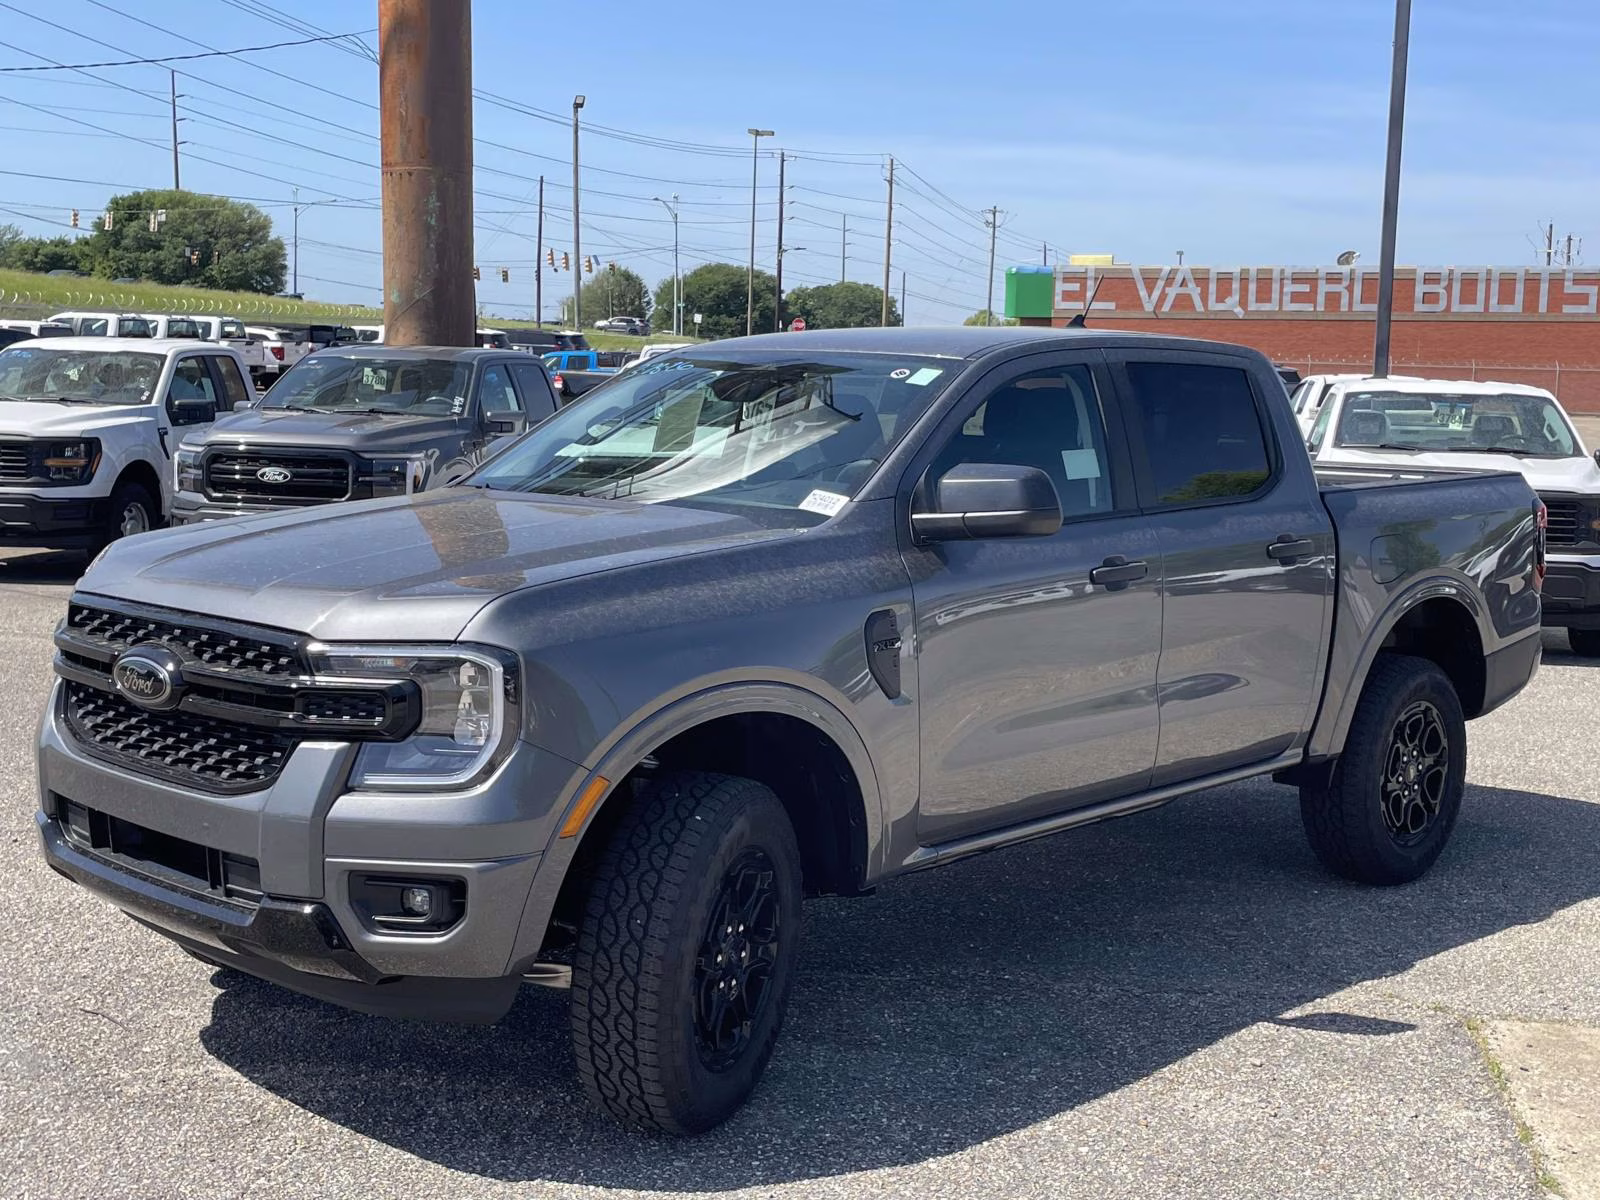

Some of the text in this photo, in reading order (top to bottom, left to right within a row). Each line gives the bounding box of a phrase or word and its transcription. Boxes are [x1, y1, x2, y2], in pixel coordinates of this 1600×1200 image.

[1054, 265, 1116, 310] EL
[1414, 265, 1599, 313] BOOTS
[124, 666, 154, 694] Ford
